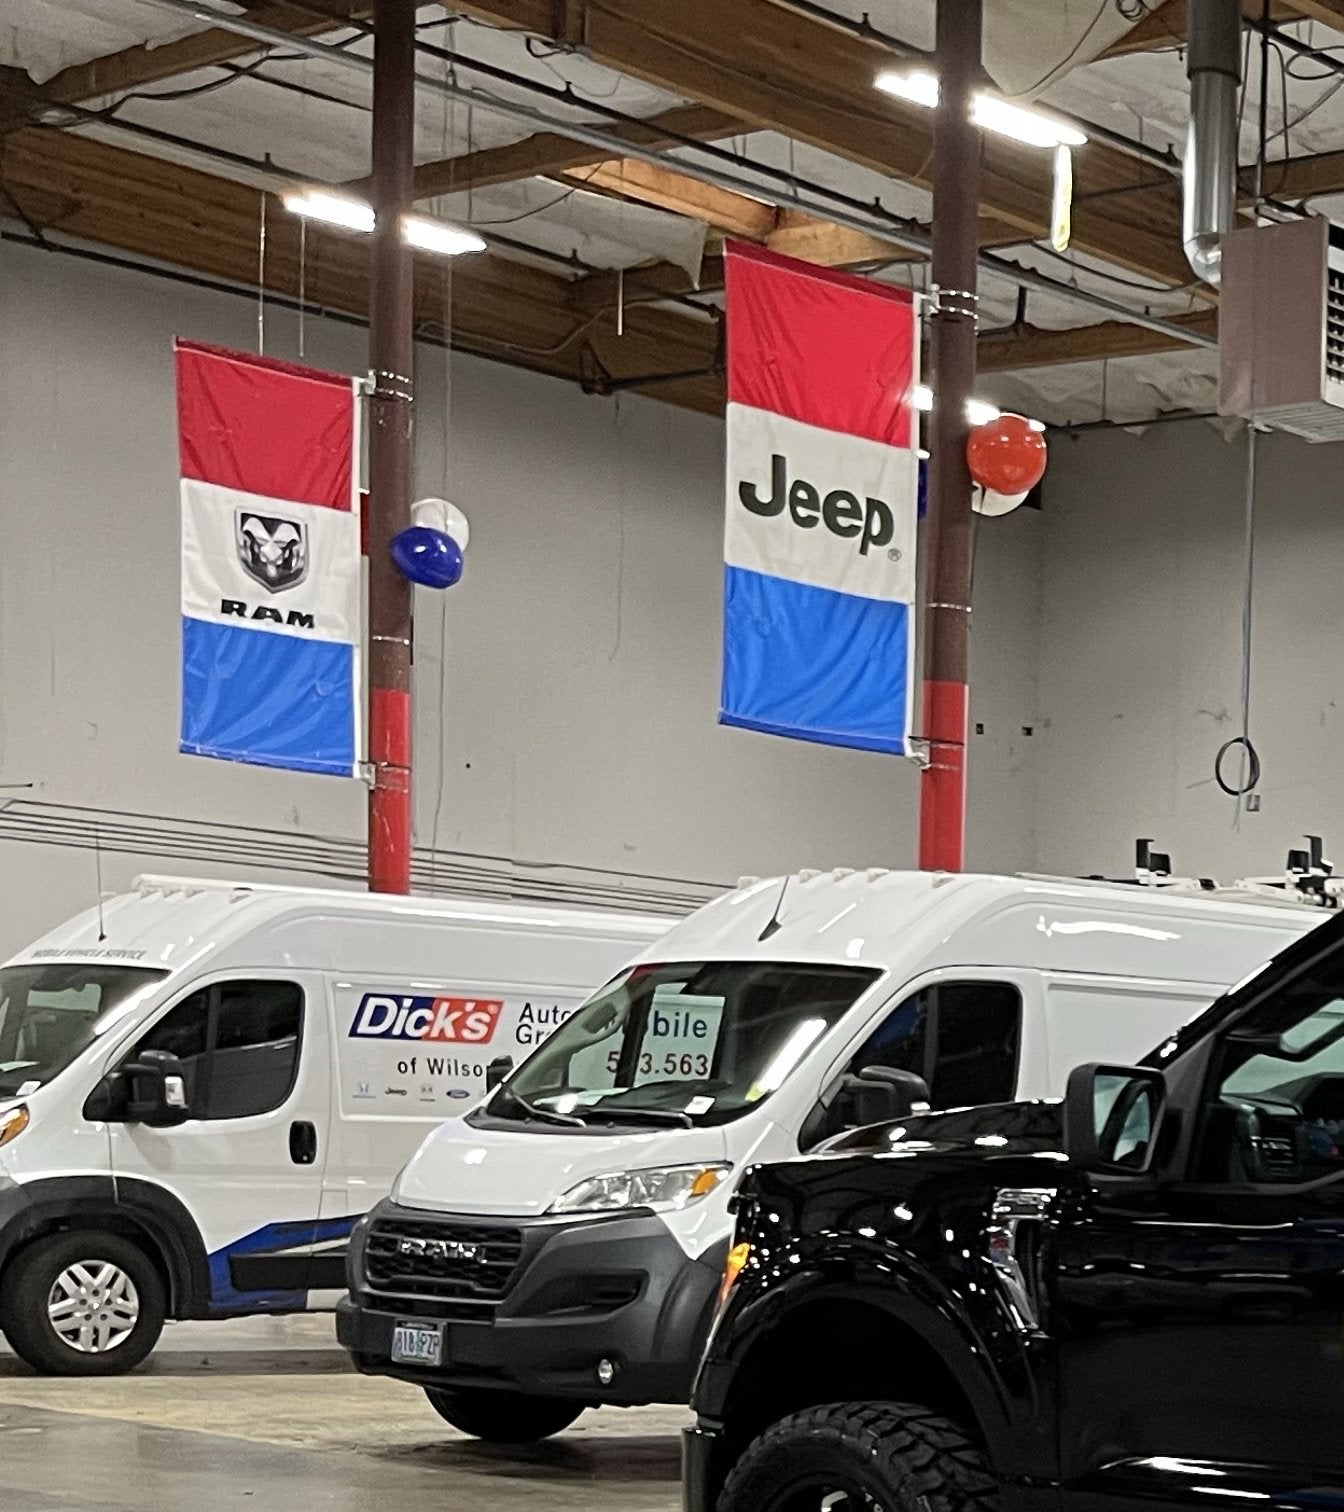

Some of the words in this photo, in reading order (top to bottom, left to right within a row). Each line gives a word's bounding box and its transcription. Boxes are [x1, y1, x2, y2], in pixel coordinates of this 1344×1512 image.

[739, 454, 894, 556] Jeep
[221, 599, 315, 629] RAM
[356, 997, 491, 1041] Dick's
[515, 1023, 550, 1045] Gr
[397, 1056, 418, 1074] of
[427, 1058, 488, 1078] Wilso
[606, 1051, 708, 1076] 53.563
